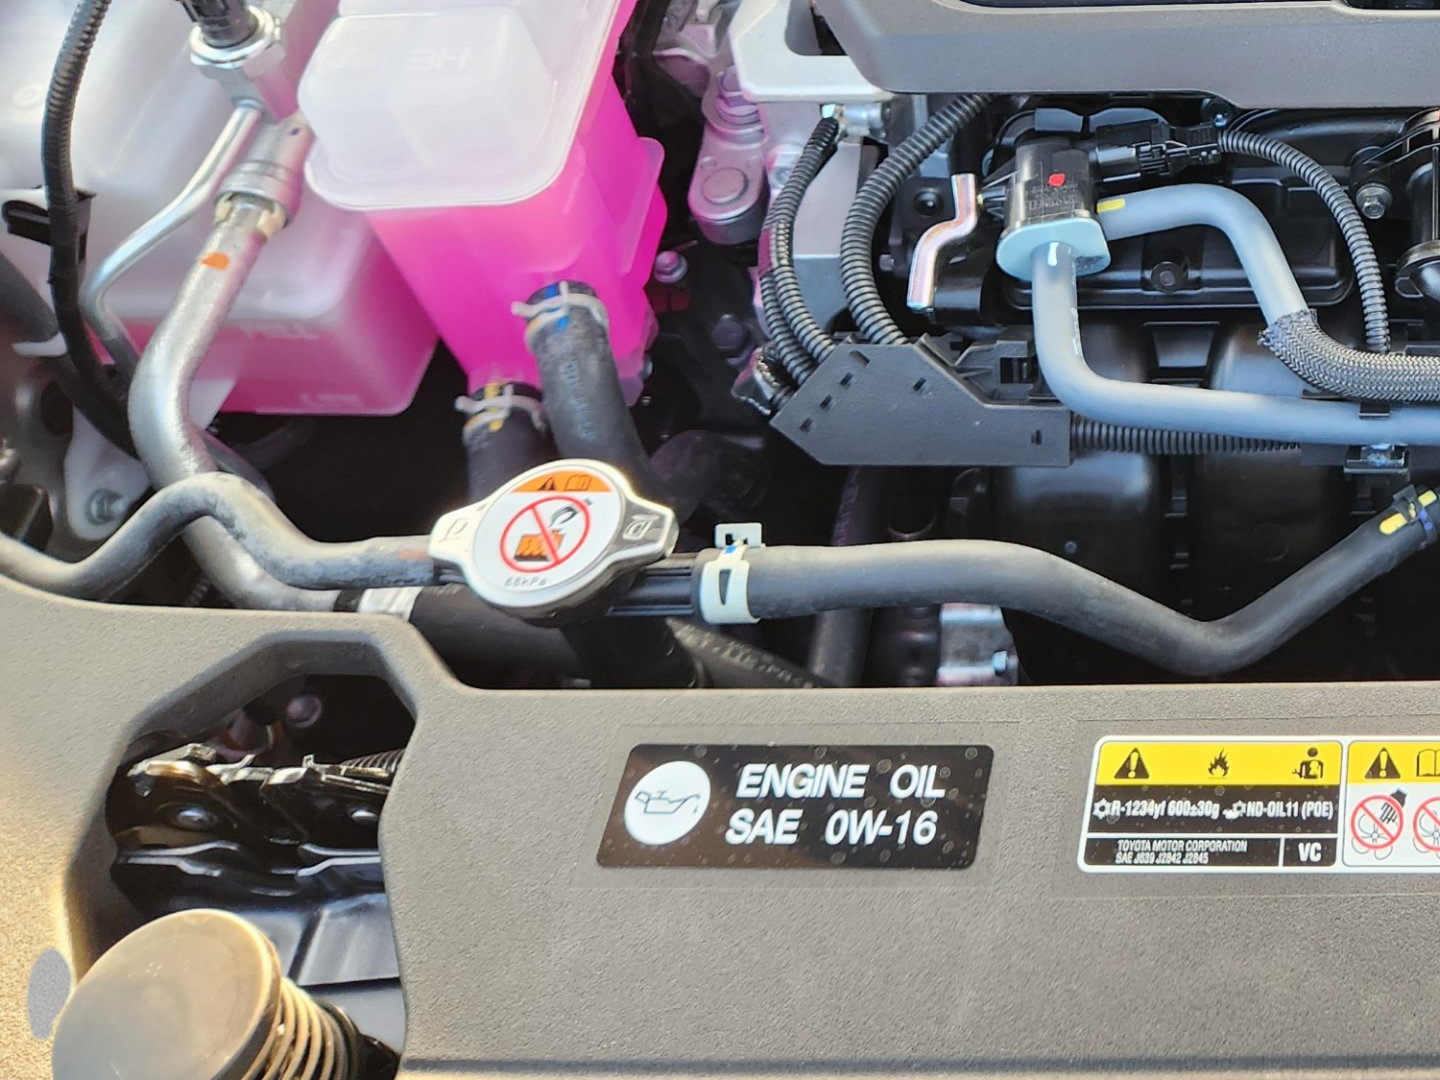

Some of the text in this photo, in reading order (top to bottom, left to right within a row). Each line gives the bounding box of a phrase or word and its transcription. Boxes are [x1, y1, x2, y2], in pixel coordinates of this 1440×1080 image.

[735, 763, 946, 799] ENGINE OIL
[1110, 800, 1334, 820] R-1234yf 600±30g ND-OIL11 (POE)
[725, 808, 938, 846] SAE 0W-16
[1117, 839, 1248, 852] TOYOTA MOTOR CORPORATION
[1298, 842, 1323, 862] VC
[1115, 851, 1133, 864] SAE
